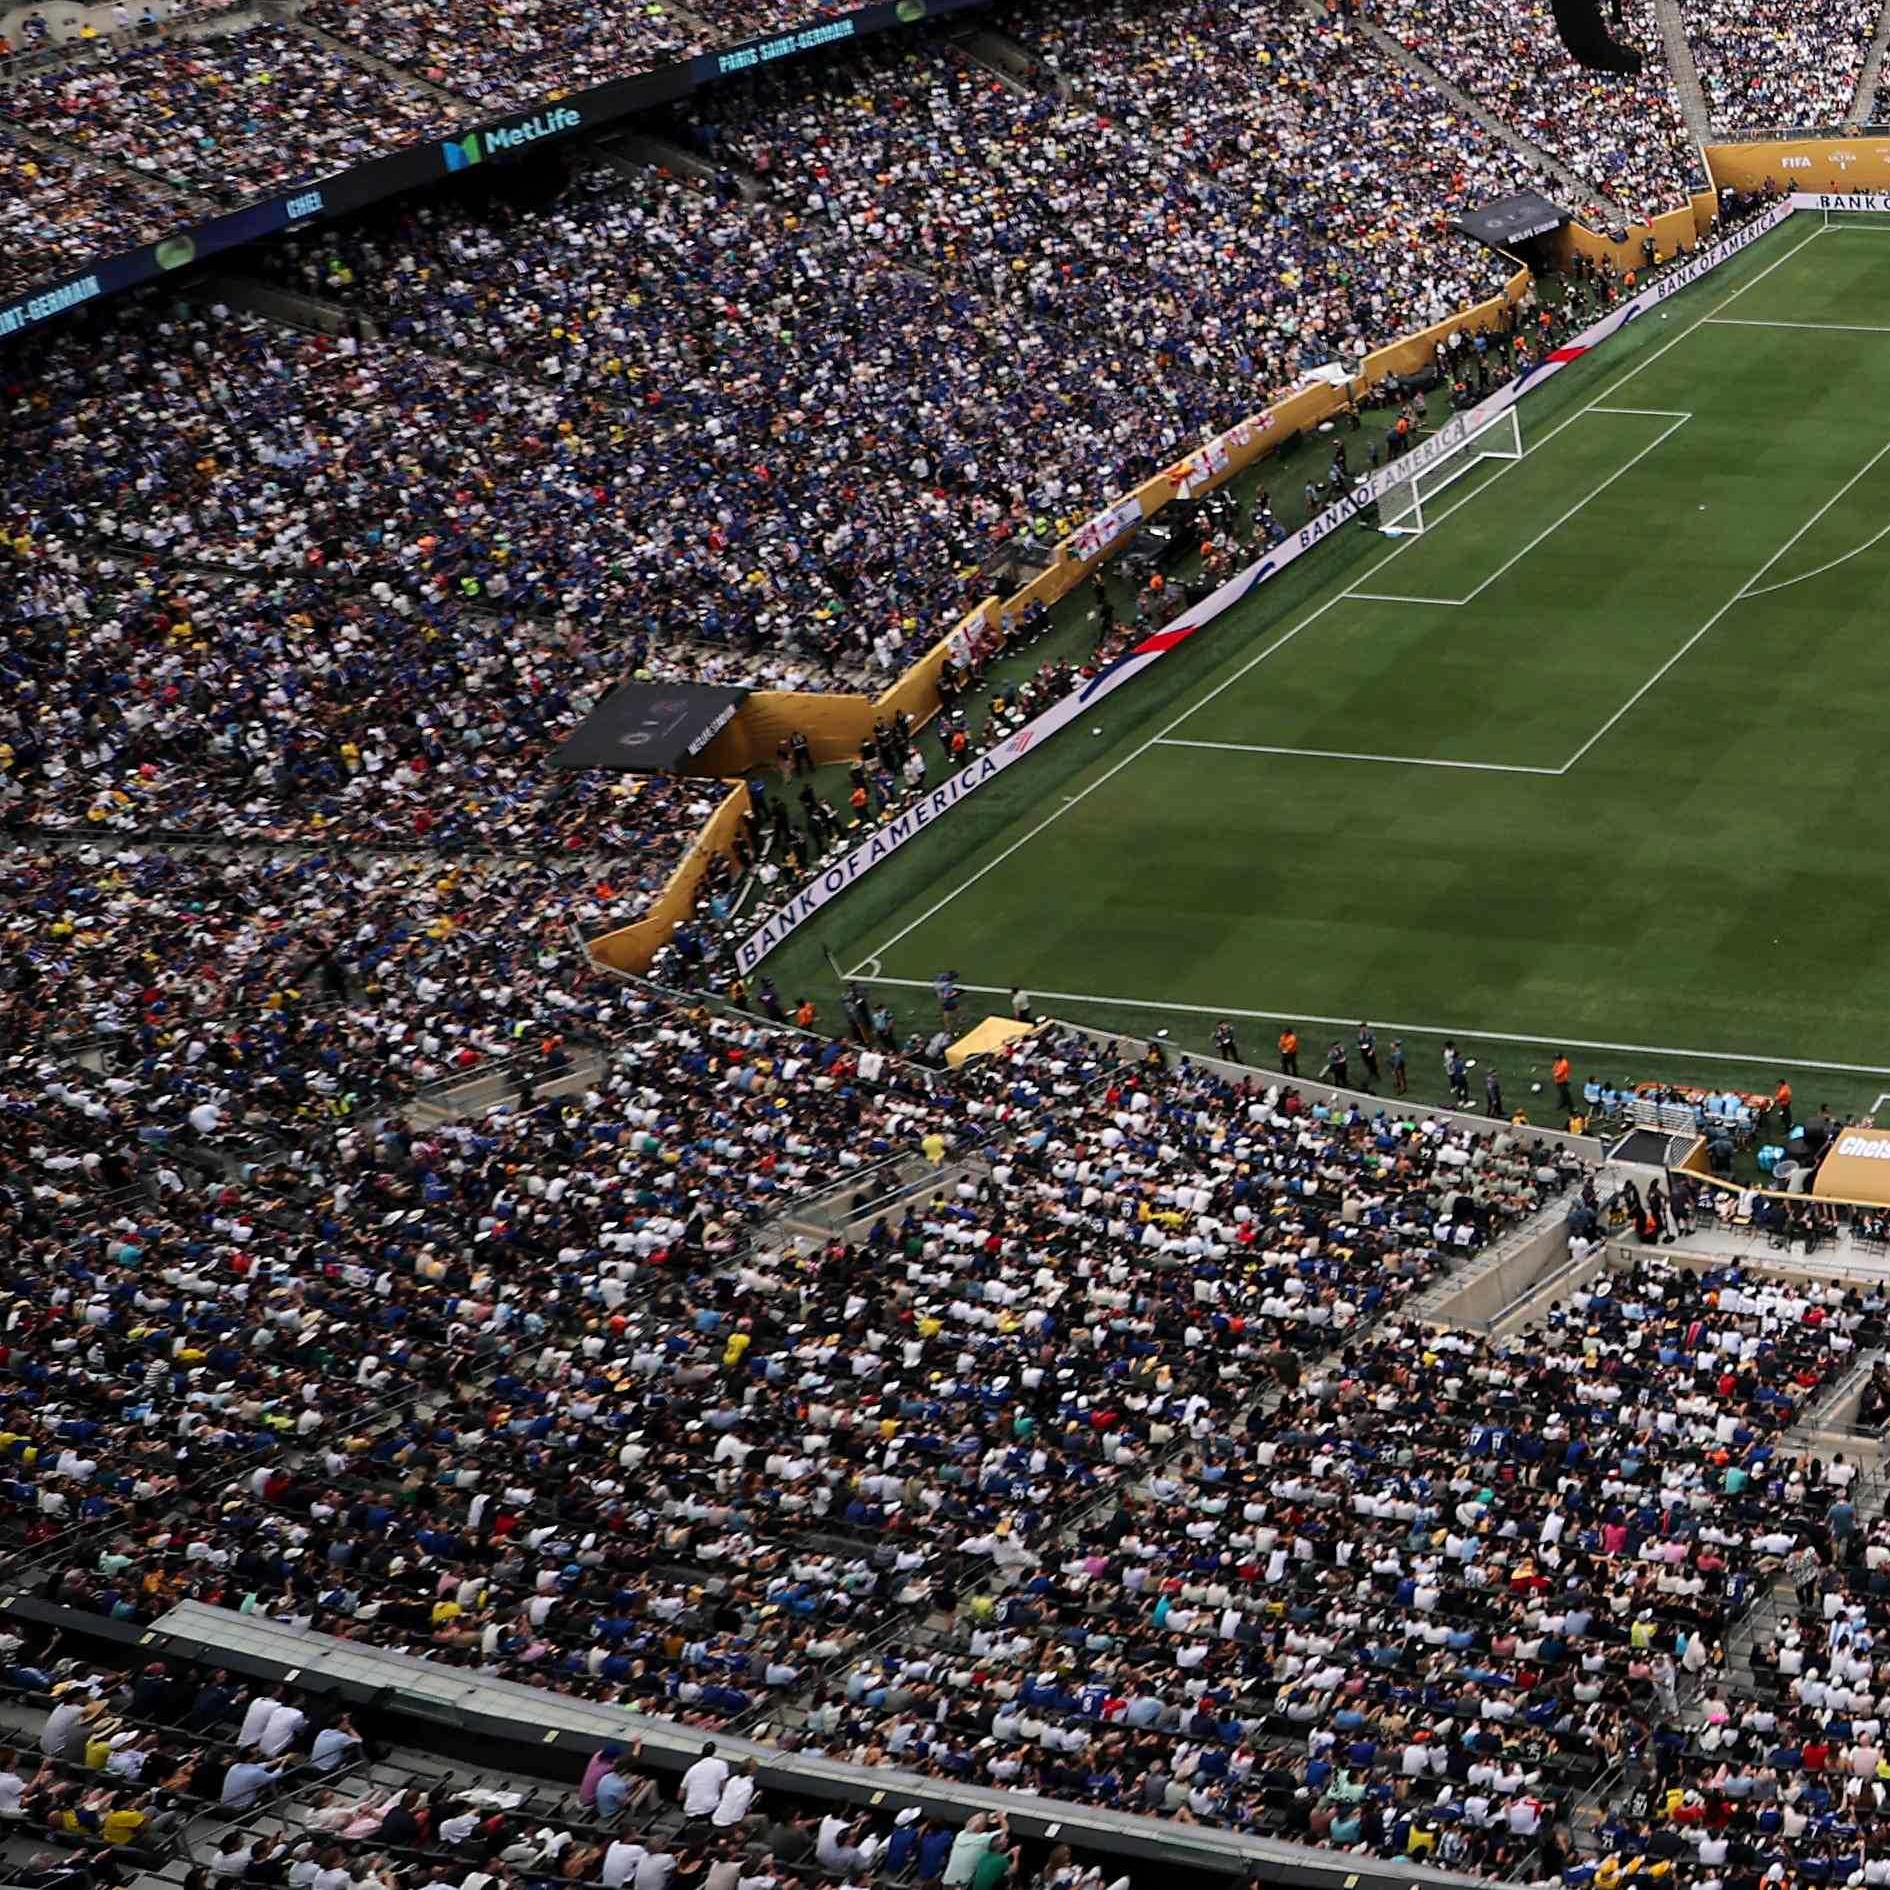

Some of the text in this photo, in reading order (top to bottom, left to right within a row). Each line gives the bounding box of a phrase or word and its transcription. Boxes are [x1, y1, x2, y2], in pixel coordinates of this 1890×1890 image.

[485, 107, 580, 156] MetLife
[1782, 157, 1811, 168] FIFA
[1820, 195, 1876, 210] BANK
[1657, 212, 1777, 298] BANK OF AMERICA
[1299, 415, 1468, 548] BANK OF AMERICA
[743, 757, 997, 968] BANK OF AMERICA
